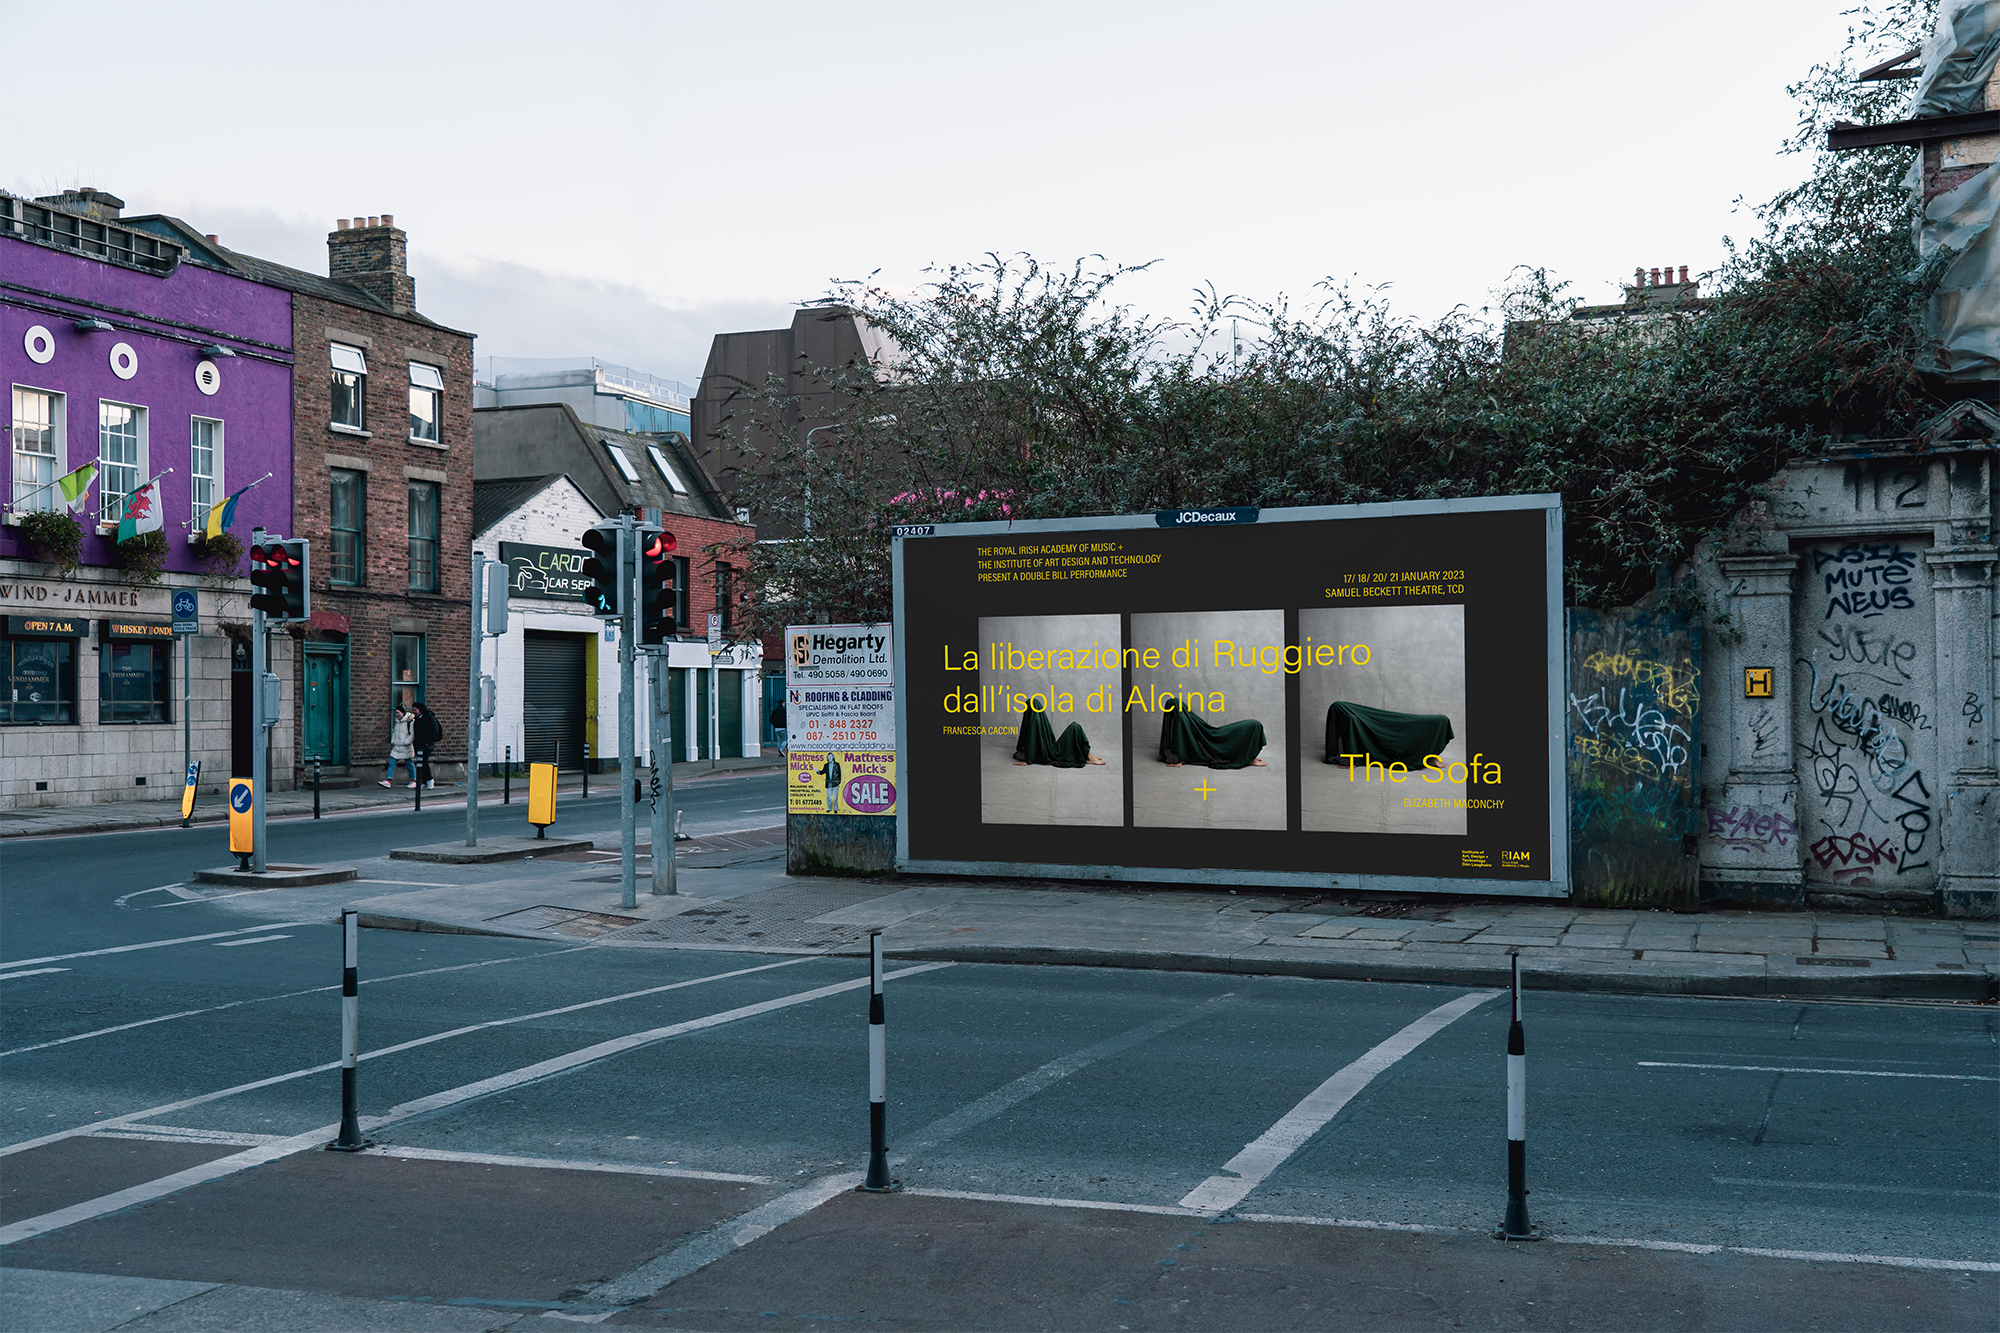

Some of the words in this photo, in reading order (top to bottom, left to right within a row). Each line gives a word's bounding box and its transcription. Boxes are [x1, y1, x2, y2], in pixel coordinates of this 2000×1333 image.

[1175, 511, 1236, 524] JCDecaux
[896, 526, 930, 536] 02407
[976, 547, 993, 556] THE
[993, 546, 1018, 556] ROYAL
[1018, 545, 1039, 555] IRISH
[1040, 544, 1078, 554] ACADEMY
[1078, 543, 1089, 552] OF
[1090, 542, 1117, 552] MUSIC
[977, 560, 993, 569] THE
[993, 558, 1032, 569] INSTITUTE
[1033, 558, 1043, 568] OF
[1044, 557, 1060, 567] ART
[1061, 556, 1090, 567] DESIGN
[1091, 556, 1109, 565] AND
[1109, 554, 1162, 565] TECHNOLOGY
[977, 572, 1012, 582] PRESENT
[1012, 572, 1019, 581] A
[1020, 571, 1051, 581] DOUBLE
[1052, 570, 1069, 580] BILL
[1070, 568, 1128, 579] PERFORMANCE
[1343, 574, 1356, 584] 17/
[1358, 573, 1371, 583] 18/
[1372, 573, 1388, 583] 20/
[1389, 573, 1399, 582] 21
[1400, 571, 1441, 582] JANUARY
[1442, 570, 1465, 580] 2023
[549, 577, 569, 589] CAR
[571, 580, 597, 590] SER
[65, 588, 139, 606] JAMMER
[1324, 587, 1362, 599] SAMUEL
[1362, 586, 1402, 597] BECKETT
[1403, 585, 1446, 596] THEATRE,
[1446, 584, 1465, 594] TCD
[24, 621, 48, 631] OPEN
[50, 622, 54, 631] 7
[55, 622, 74, 632] A.M.
[111, 624, 148, 635] WHISKEY
[813, 634, 886, 654] Hegarty
[812, 654, 865, 665] Demolition
[869, 653, 888, 664] Ltd.
[944, 644, 979, 672] La
[990, 640, 1161, 671] liberazione
[1171, 638, 1200, 669] di
[1213, 636, 1372, 675] Ruggiero
[793, 671, 806, 679] Tel.
[867, 669, 888, 677] 0690
[1750, 673, 1767, 693] H
[805, 692, 840, 702] ROOFING
[841, 692, 849, 702] &
[850, 690, 893, 701] CLADDING
[942, 683, 1074, 714] dall'isola
[1085, 683, 1113, 713] di
[1124, 683, 1226, 713] Alcina
[808, 720, 819, 729] 01
[829, 720, 847, 729] 848
[849, 719, 873, 729] 2327
[942, 725, 987, 736] FRANCESCA
[987, 726, 1020, 736] CACCINI
[806, 732, 823, 741] 087
[832, 731, 856, 741] 2510
[859, 731, 877, 740] 750
[790, 753, 825, 762] Mattress
[844, 753, 895, 763] Mattress
[790, 762, 814, 771] Mick's
[852, 764, 887, 774] Mick's
[1339, 752, 1410, 784] The
[1421, 752, 1502, 785] Sofa
[850, 782, 889, 805] SALE
[1403, 797, 1451, 809] ELIZABETH
[1453, 798, 1505, 810] MACONCHY
[1501, 850, 1530, 861] RIAM
